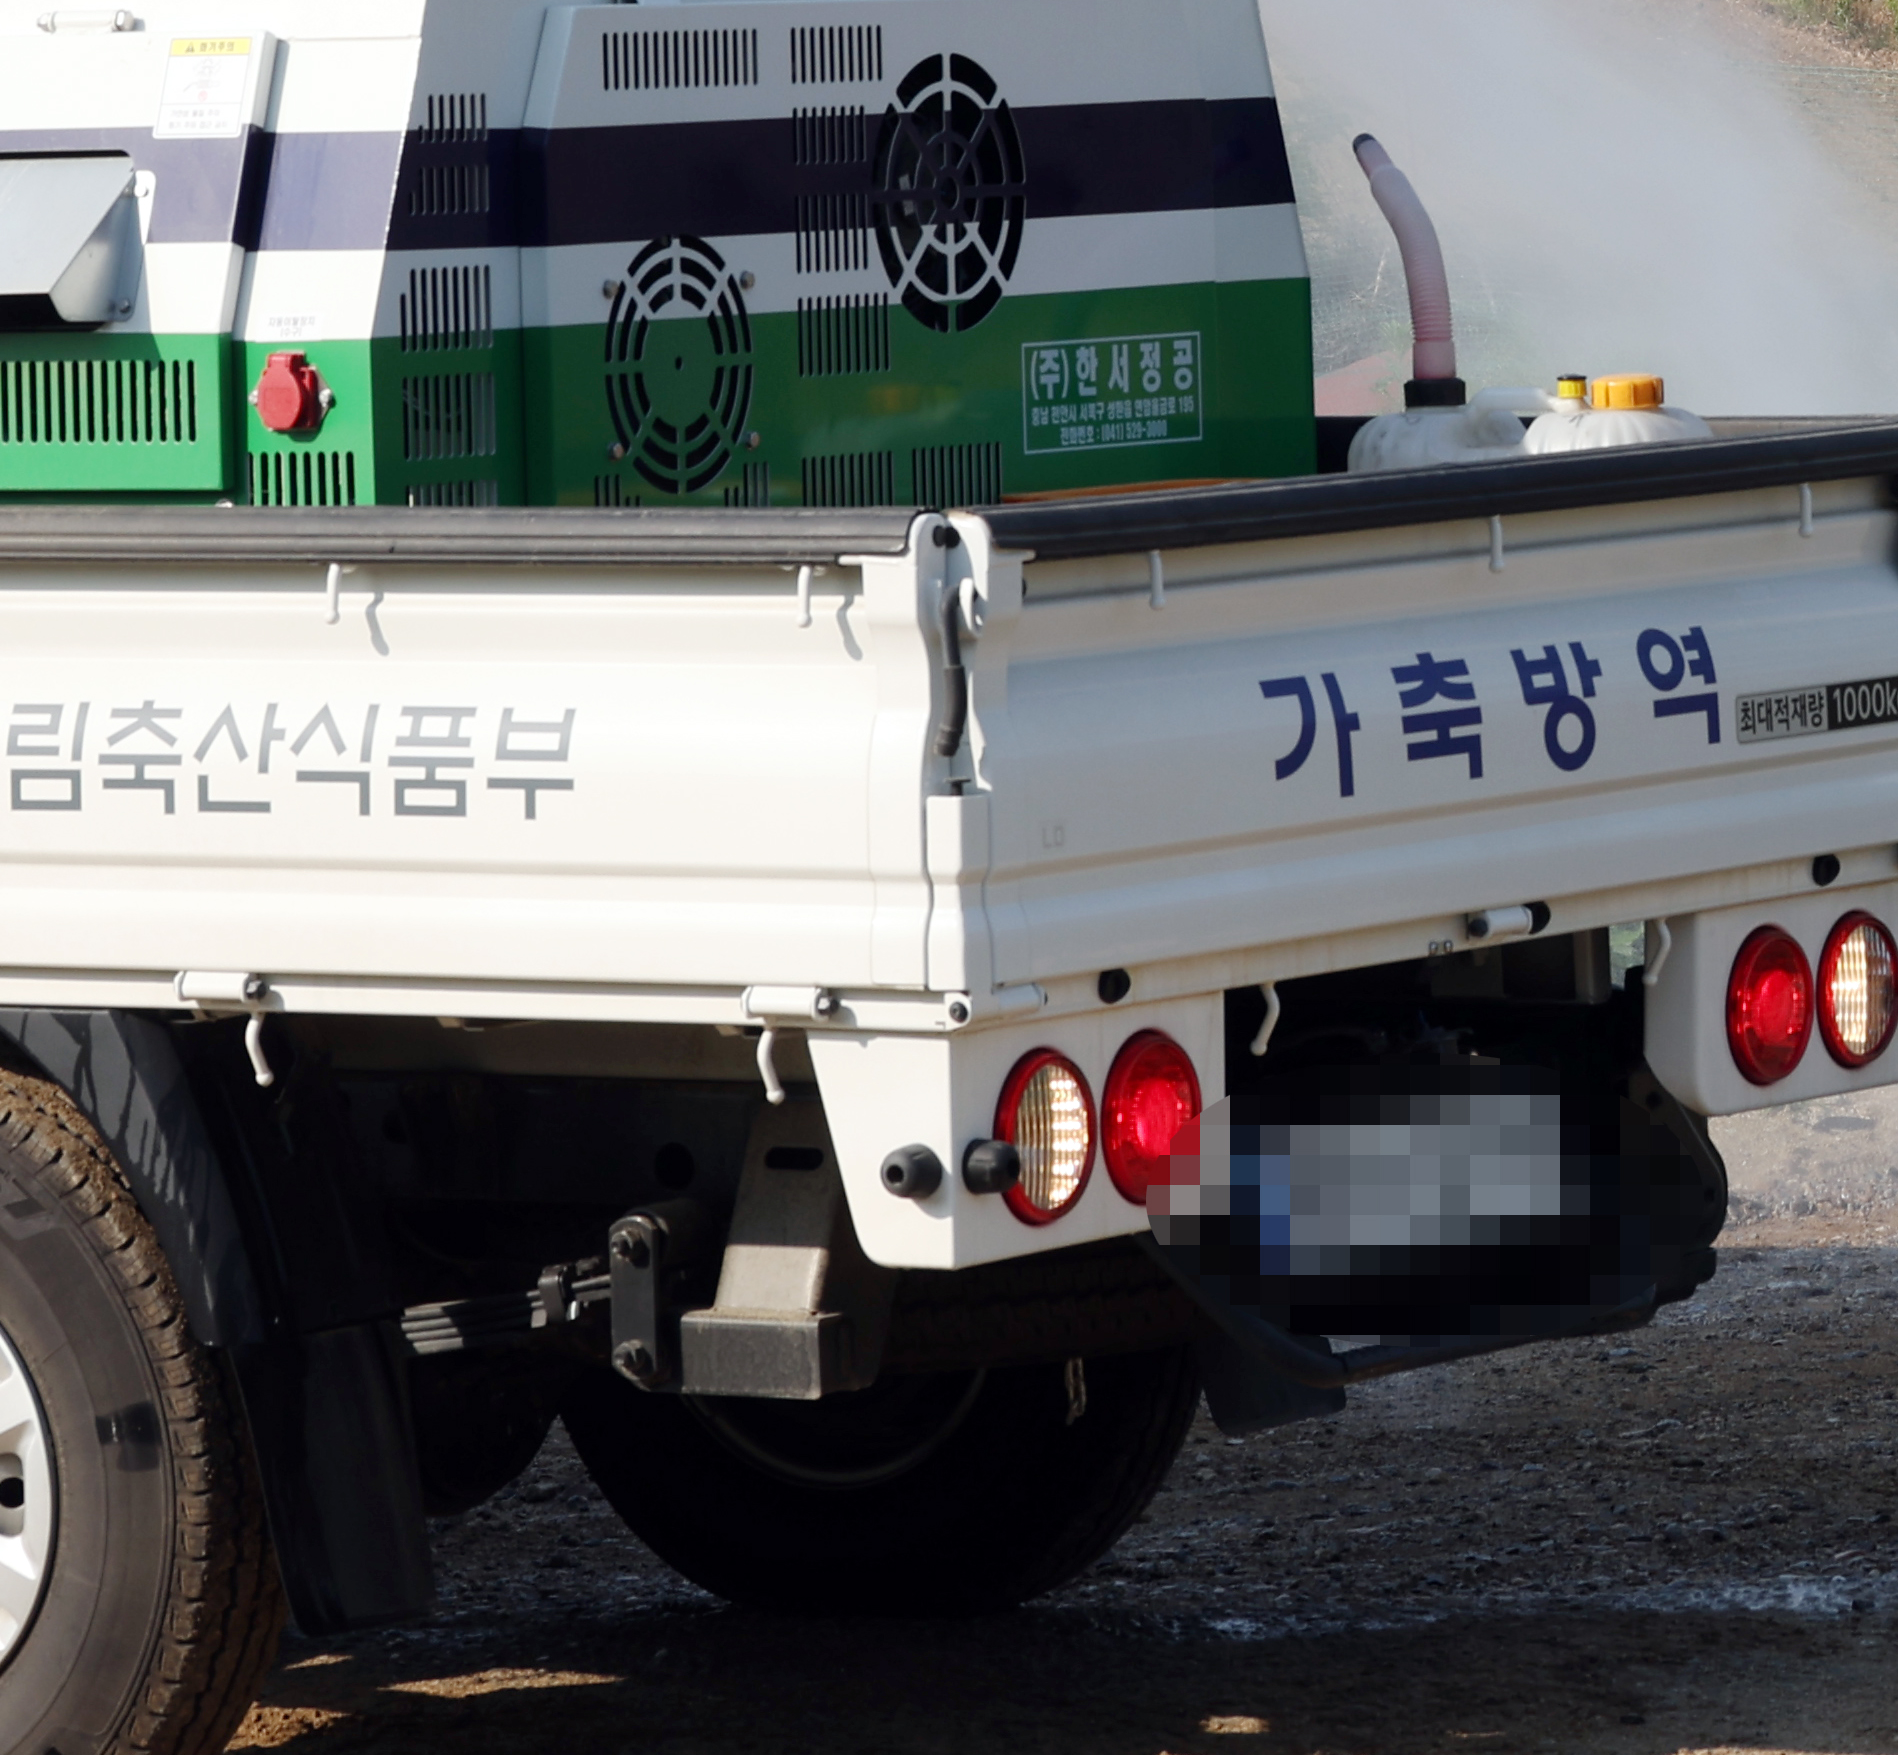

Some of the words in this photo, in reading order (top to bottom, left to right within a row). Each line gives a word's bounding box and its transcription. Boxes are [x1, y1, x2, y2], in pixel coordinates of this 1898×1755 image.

[1032, 407, 1049, 426] 충남
[1051, 405, 1077, 424] 천안시
[1080, 402, 1104, 421] 서북구
[1259, 625, 1721, 798] 가축방역
[1740, 691, 1824, 735] 최대적재량
[5, 699, 577, 821] 림축산식품부
